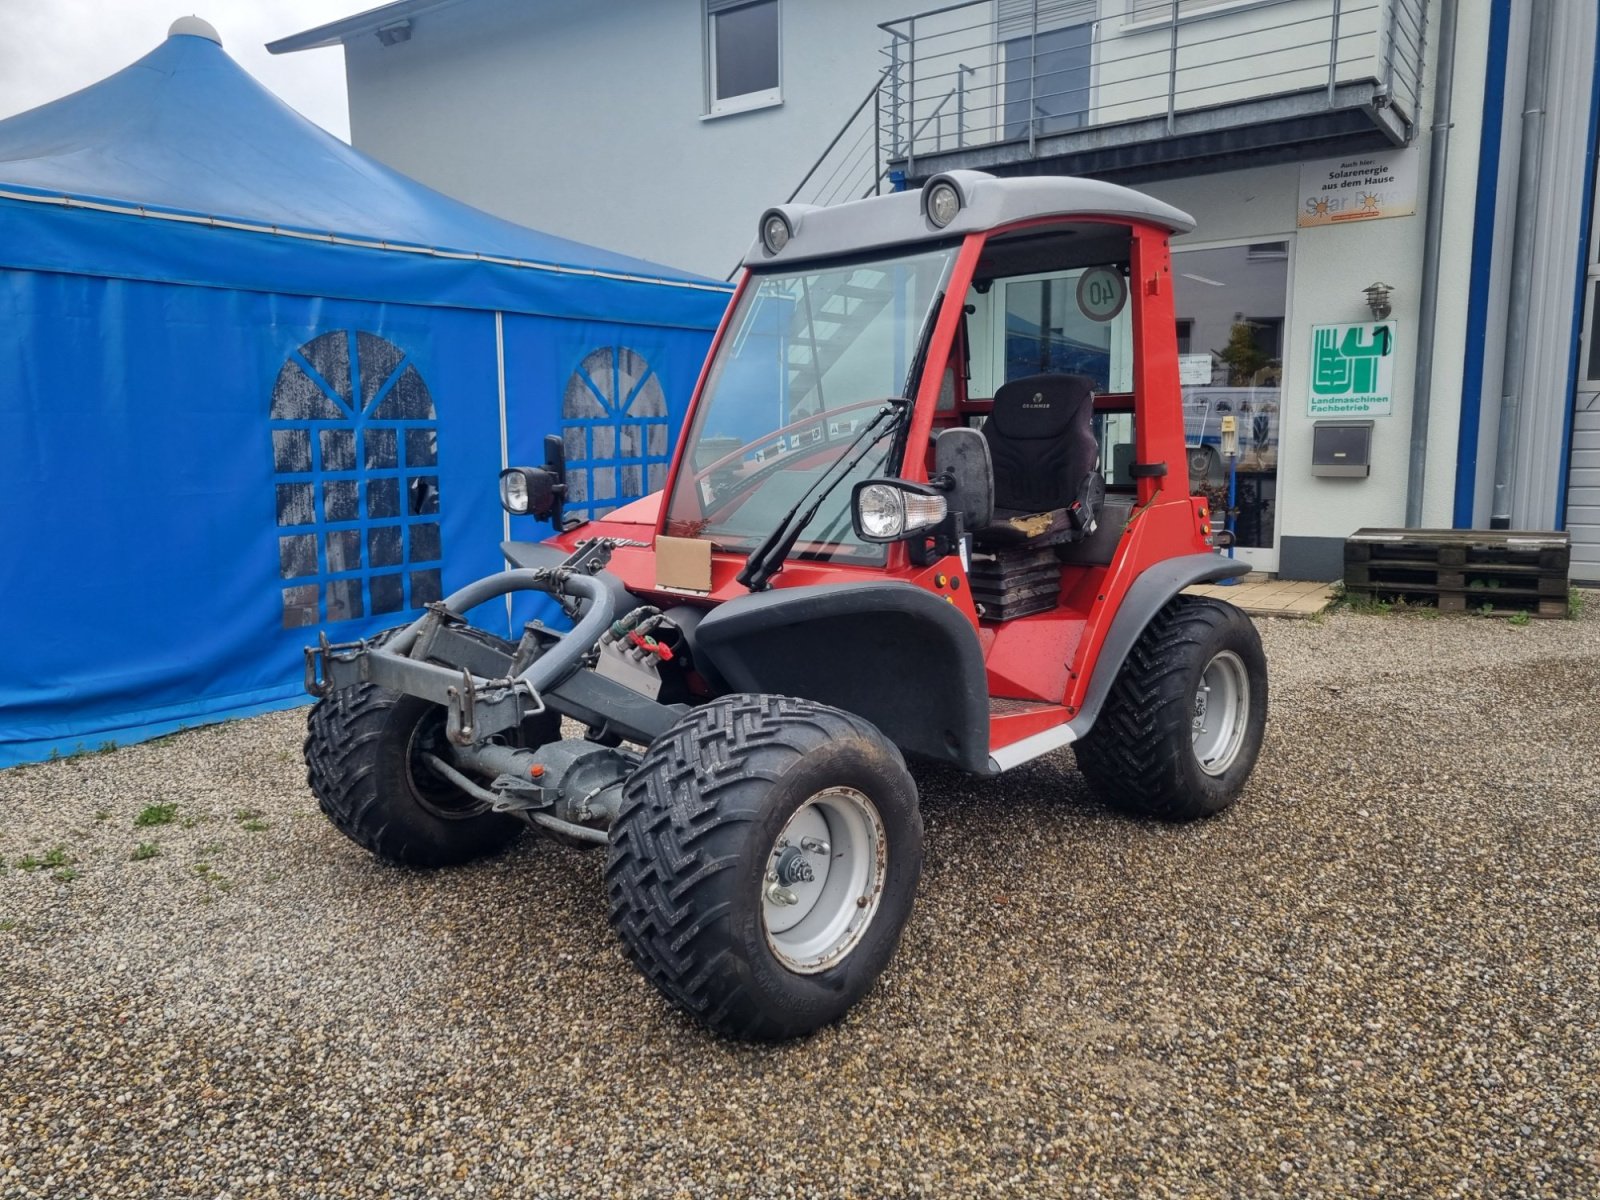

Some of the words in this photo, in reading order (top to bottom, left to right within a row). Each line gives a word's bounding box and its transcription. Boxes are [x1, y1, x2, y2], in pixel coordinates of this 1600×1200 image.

[1340, 161, 1358, 169] Auch
[1359, 159, 1376, 167] hier:
[1328, 164, 1389, 180] Solarenergie
[1321, 183, 1338, 191] aus
[1340, 179, 1362, 188] dem
[1364, 176, 1395, 185] Hause
[1311, 395, 1389, 405] Landmaschinen
[1310, 404, 1370, 412] Fachbetrieb
